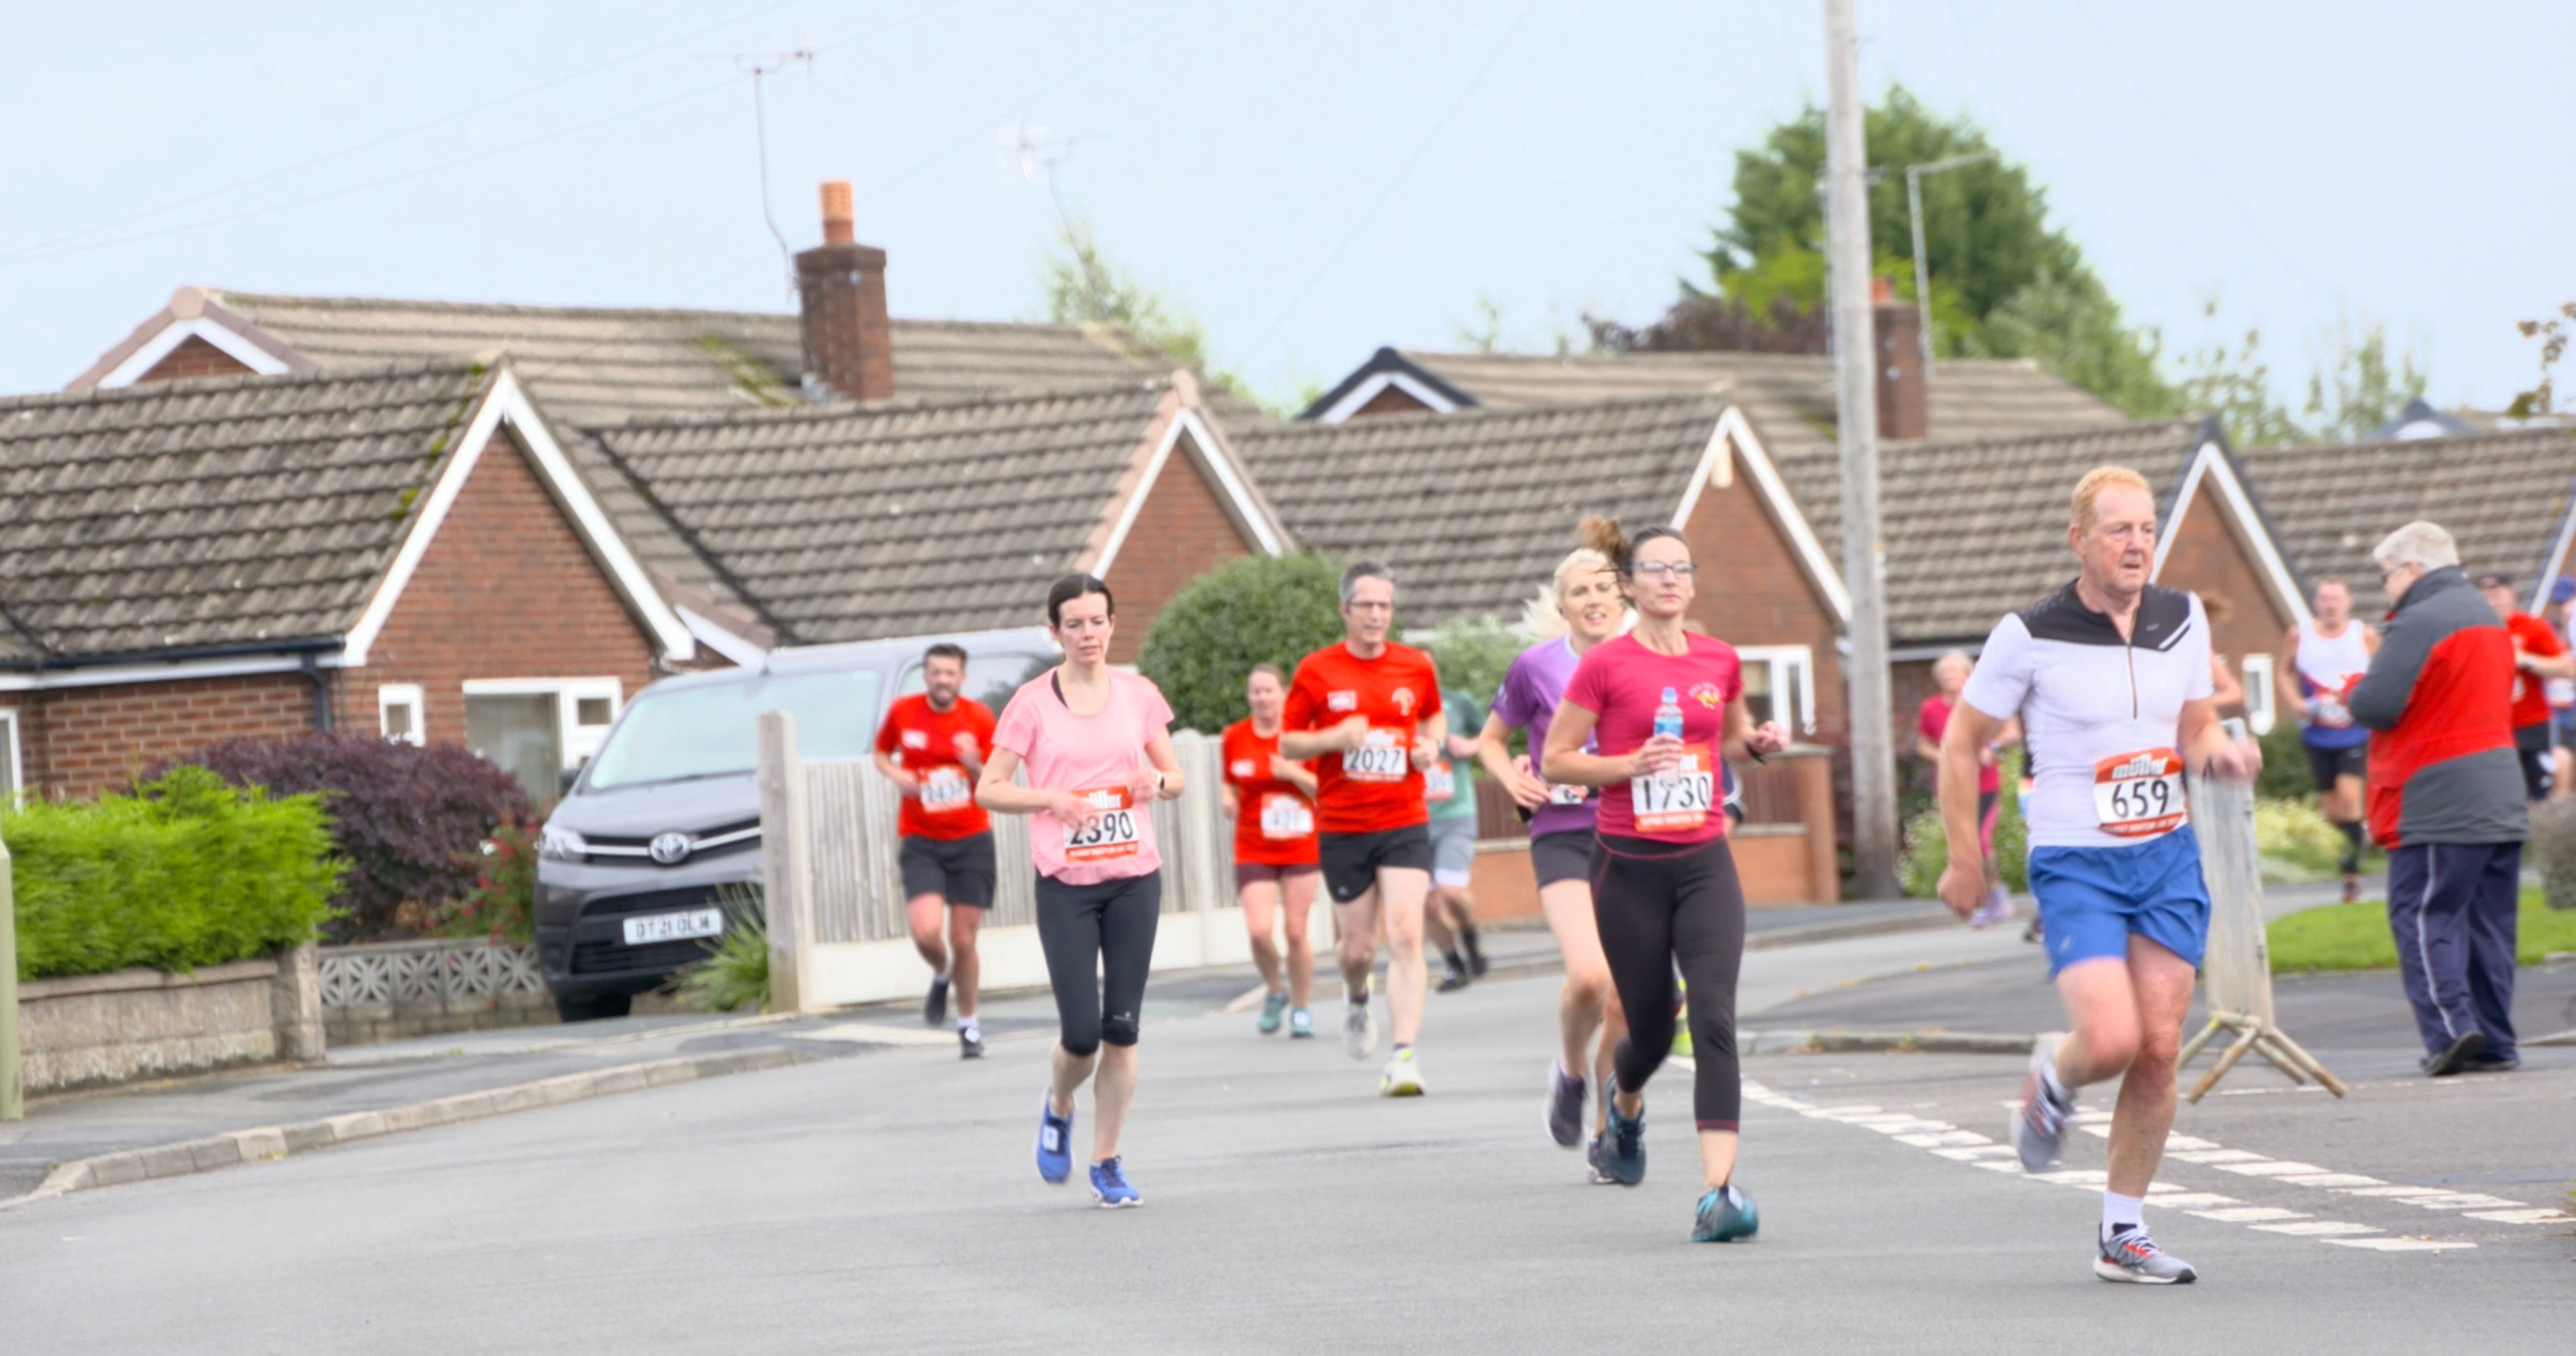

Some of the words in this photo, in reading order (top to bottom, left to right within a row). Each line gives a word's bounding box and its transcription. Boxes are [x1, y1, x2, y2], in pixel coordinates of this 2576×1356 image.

[1347, 747, 1401, 771] 2027
[2112, 779, 2169, 818] 659
[1070, 811, 1133, 845] 2390
